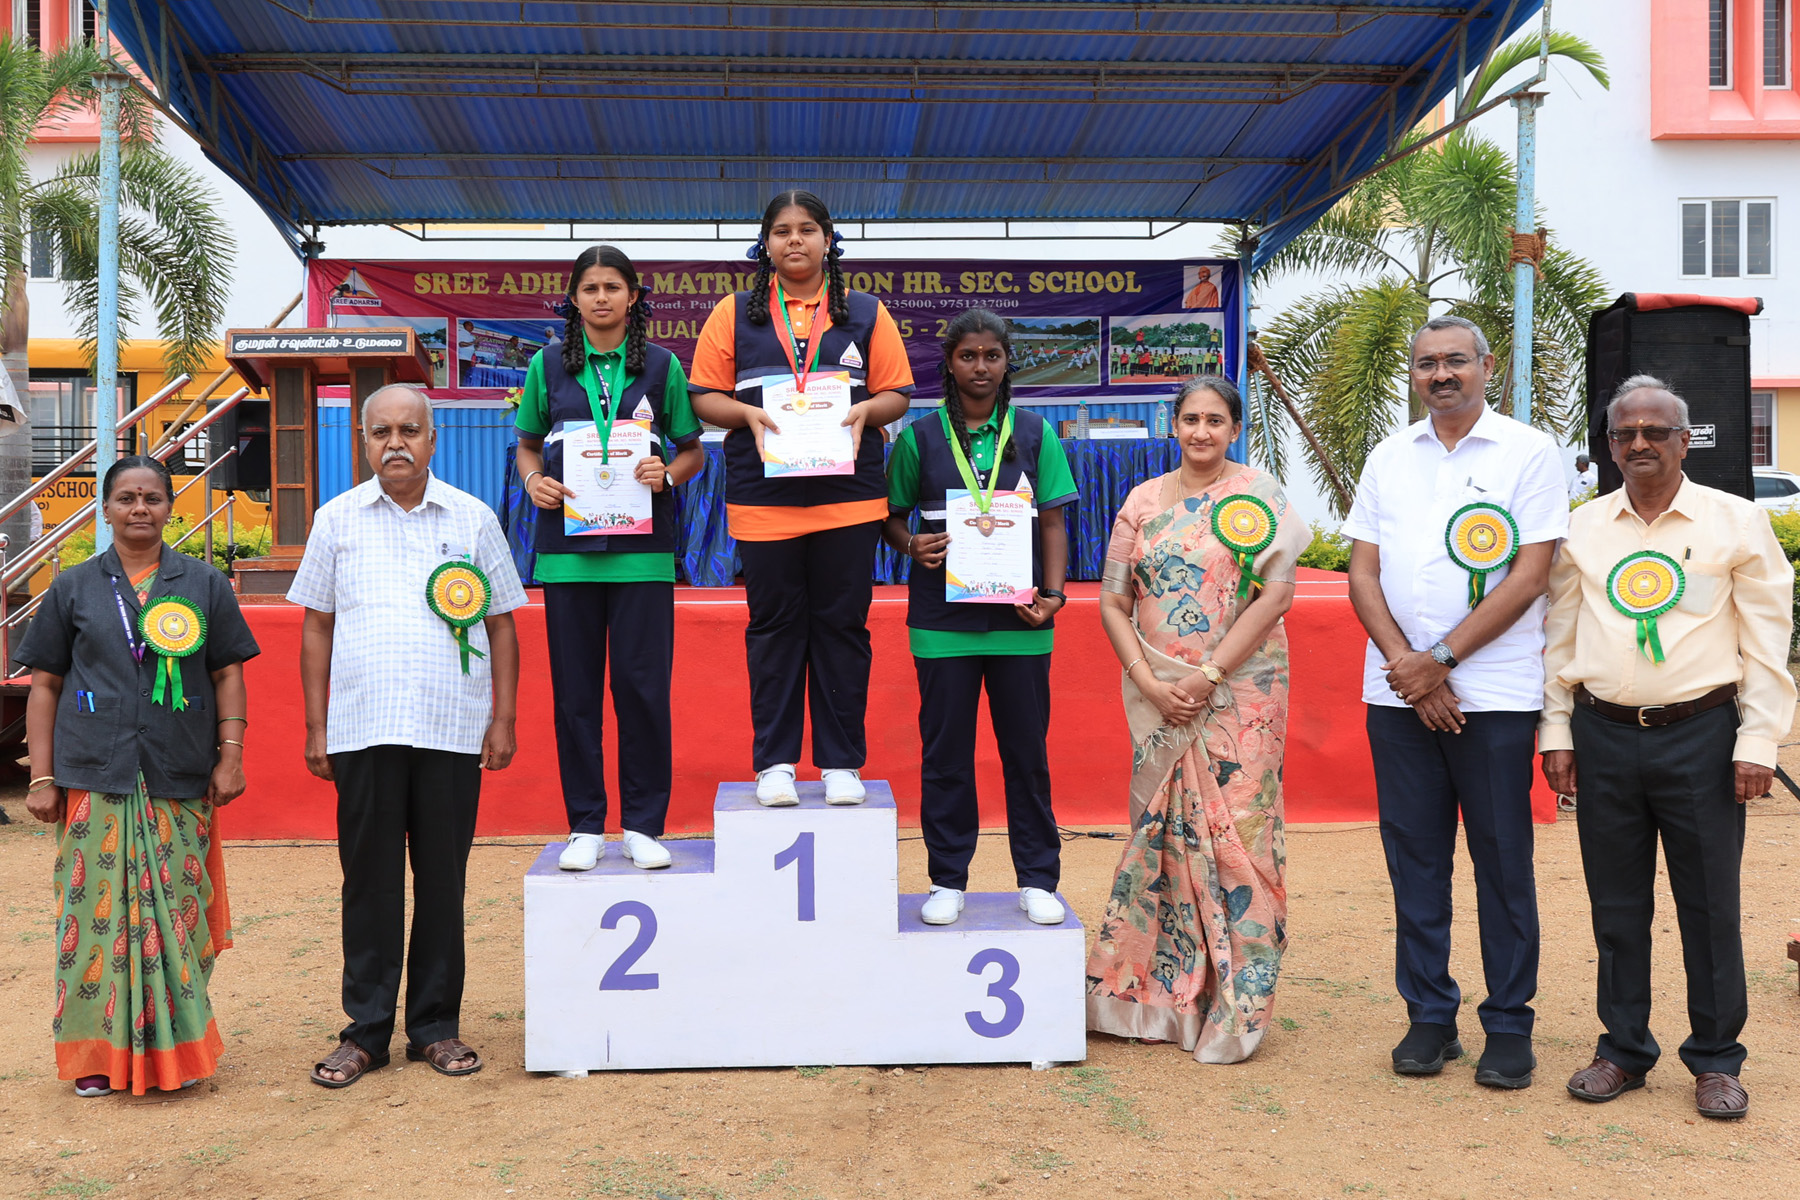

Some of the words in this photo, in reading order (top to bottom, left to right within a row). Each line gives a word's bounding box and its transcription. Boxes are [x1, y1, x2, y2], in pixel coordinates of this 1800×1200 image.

[414, 272, 490, 295] SREE
[902, 271, 952, 294] HR.
[959, 271, 1021, 294] SEC.
[1028, 270, 1142, 293] SCHOOL
[885, 299, 936, 309] 235000,
[645, 320, 700, 339] NUAL
[235, 337, 279, 351] குமரன்
[774, 831, 816, 922] 1
[599, 900, 659, 991] 2
[964, 948, 1025, 1038] 3
